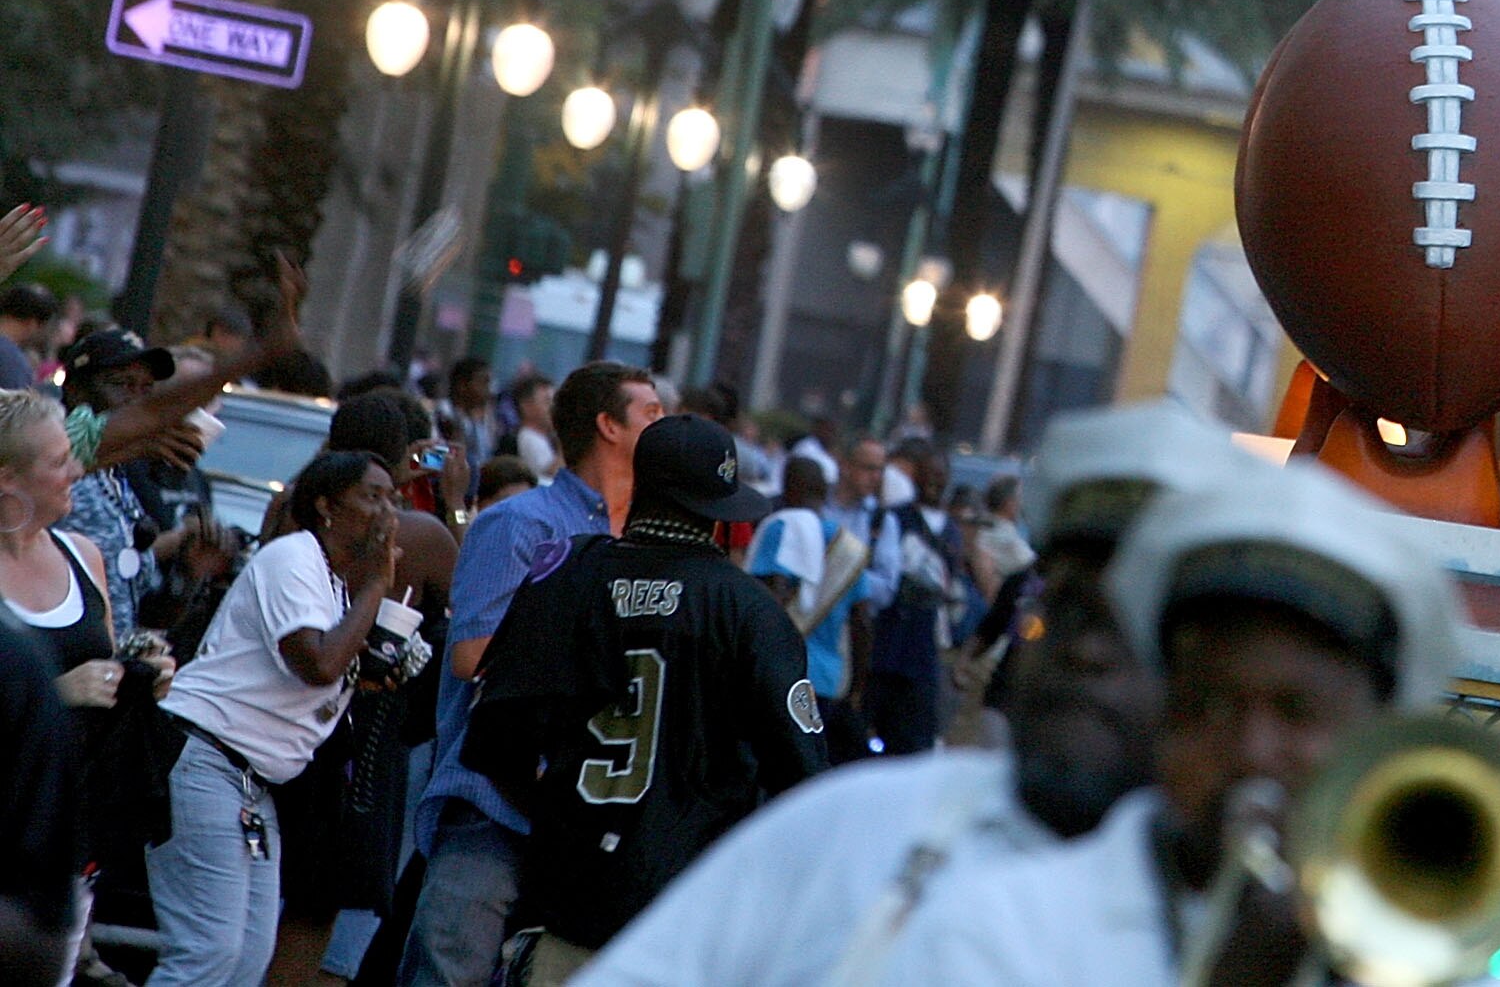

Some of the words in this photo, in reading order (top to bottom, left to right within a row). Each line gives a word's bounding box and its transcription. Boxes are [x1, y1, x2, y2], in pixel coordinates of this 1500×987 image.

[168, 10, 220, 54] ONE
[226, 25, 285, 65] WAY
[609, 578, 683, 618] REES
[576, 648, 666, 804] 9
